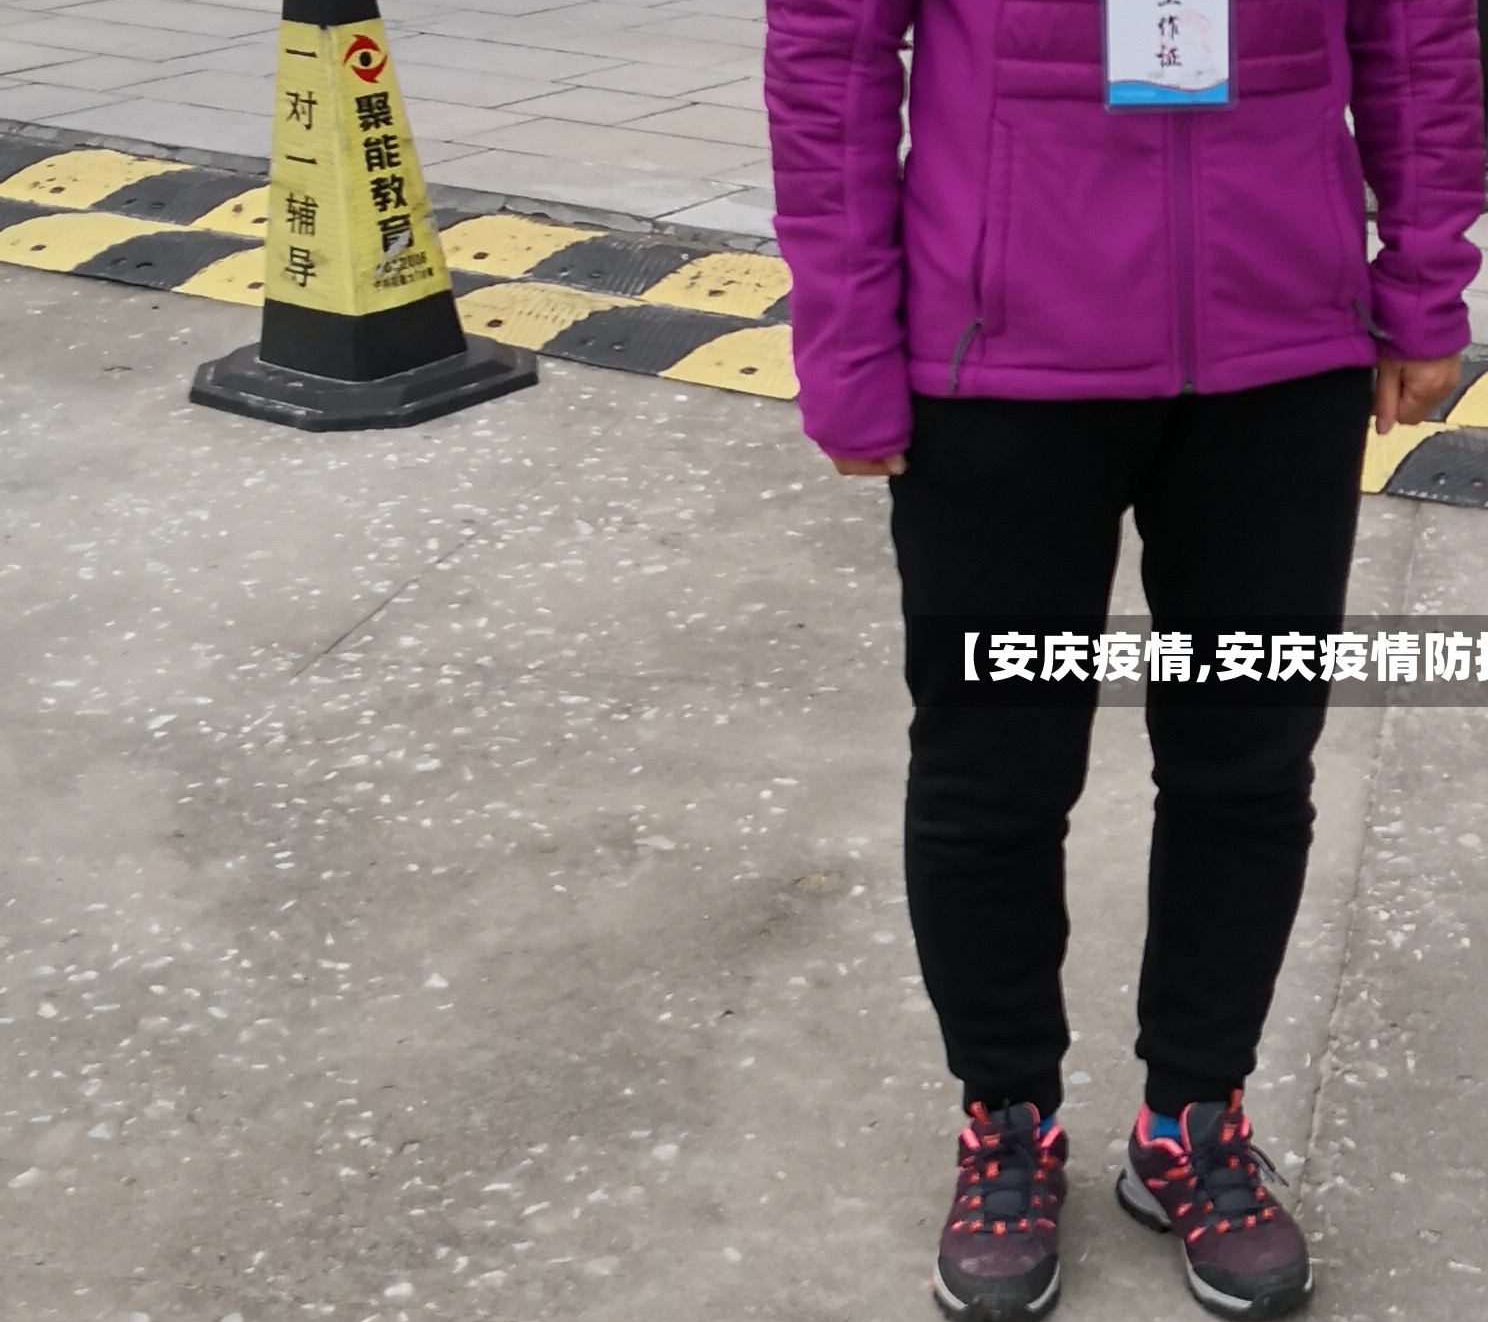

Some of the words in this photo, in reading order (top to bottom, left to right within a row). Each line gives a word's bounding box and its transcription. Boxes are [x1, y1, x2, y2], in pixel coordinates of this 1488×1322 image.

[285, 47, 319, 288] 一对一辅导
[355, 91, 415, 254] 聚能教育
